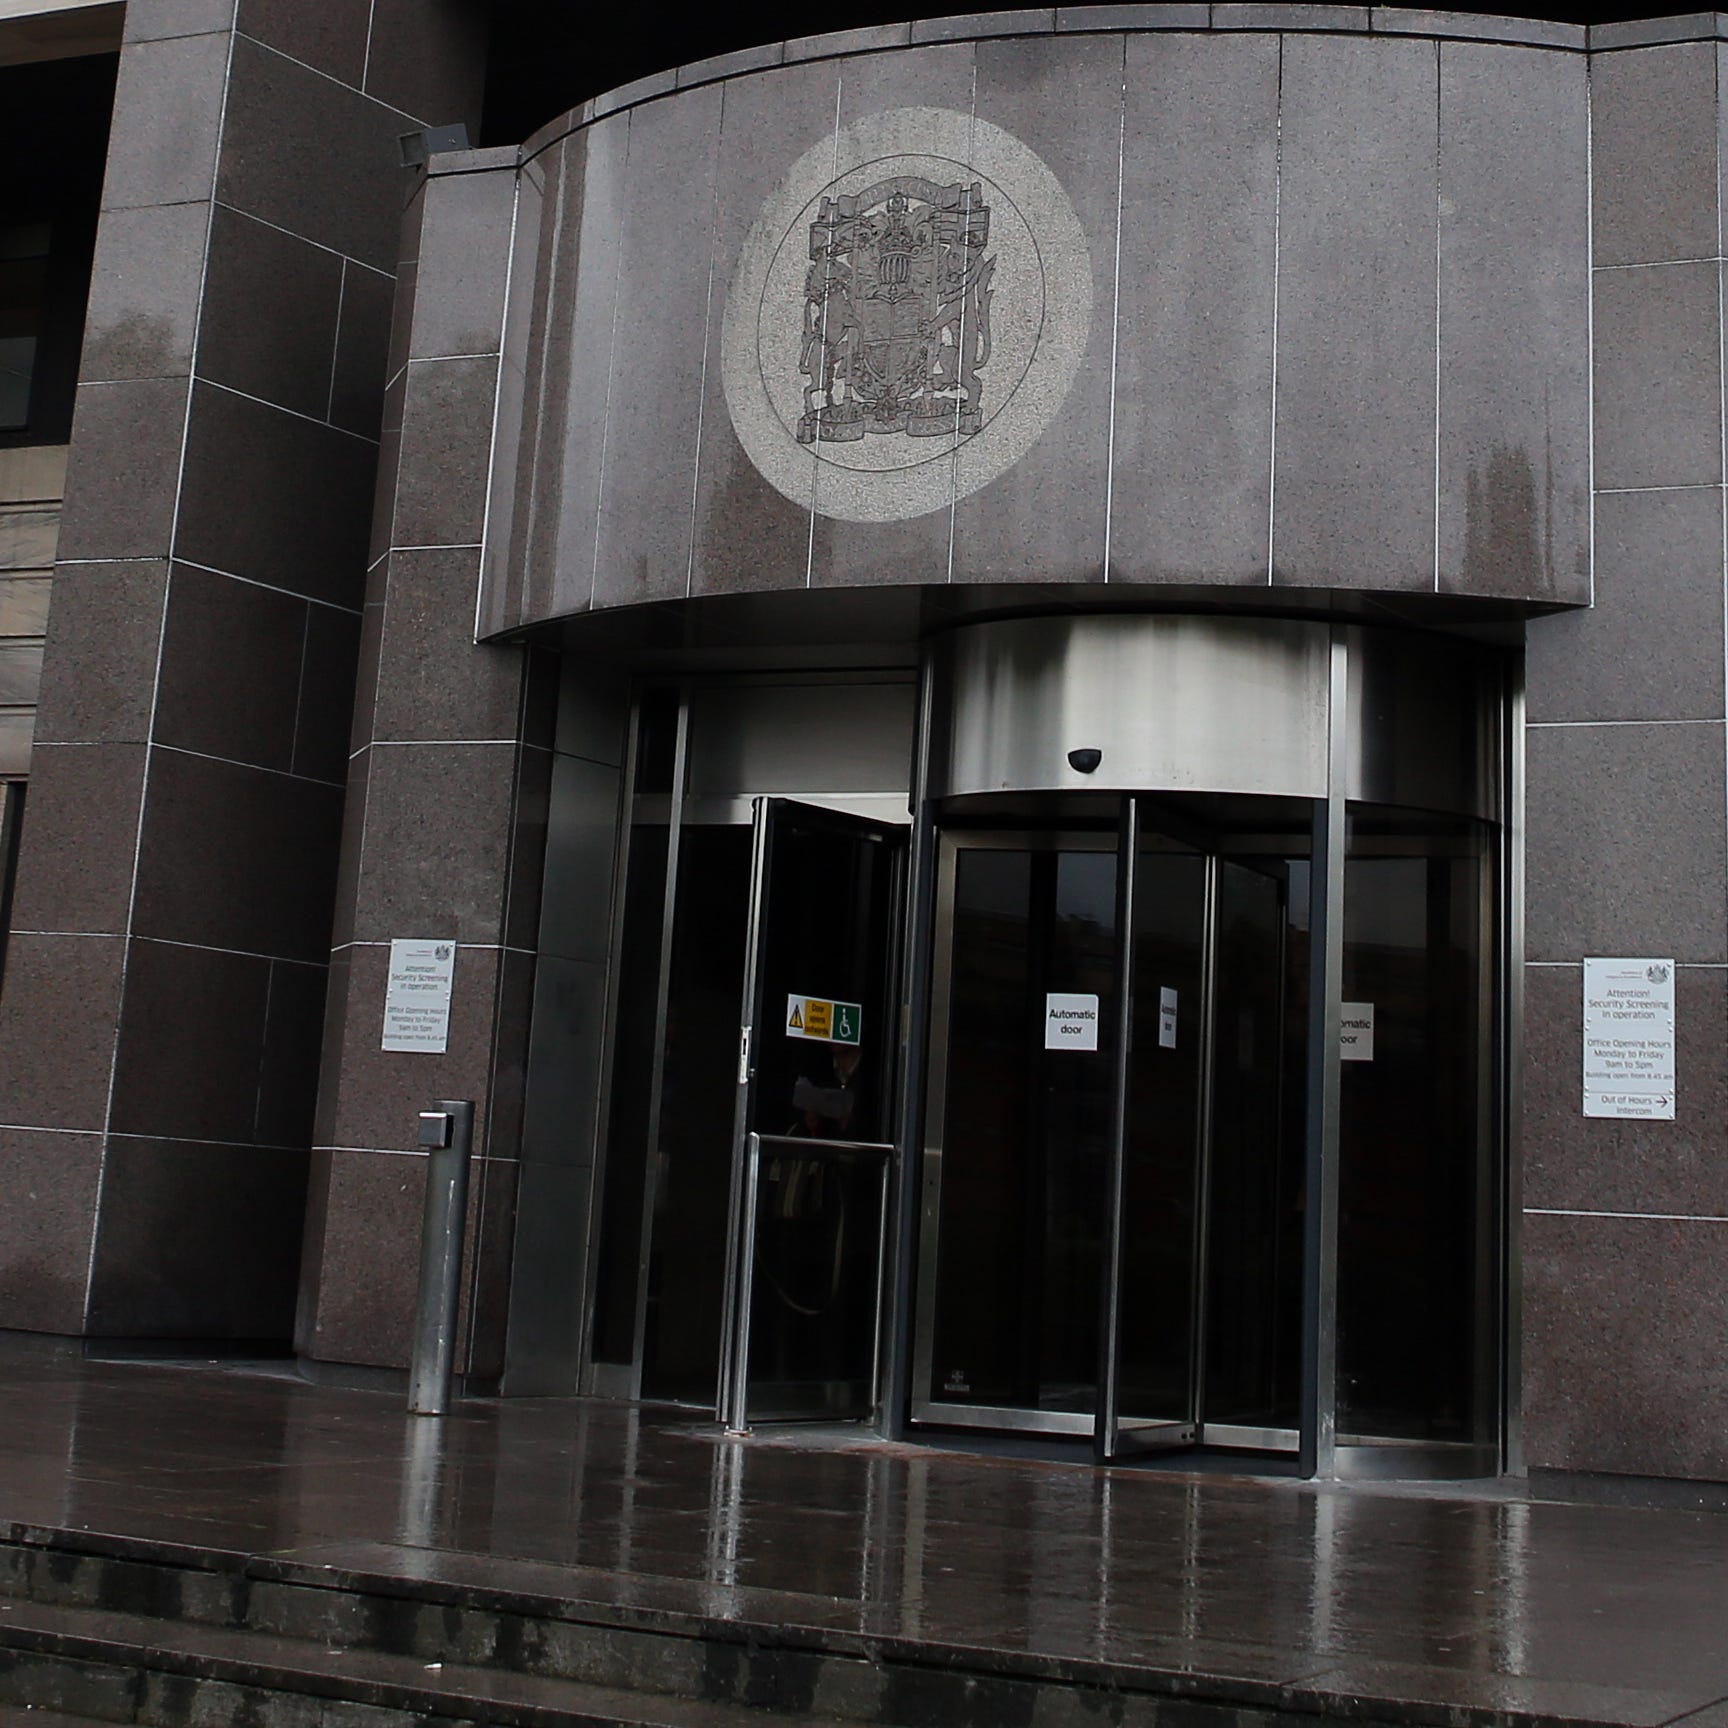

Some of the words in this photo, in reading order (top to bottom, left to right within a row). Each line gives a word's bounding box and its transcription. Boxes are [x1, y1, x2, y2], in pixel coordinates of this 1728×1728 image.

[1588, 999, 1625, 1009] Security
[1626, 999, 1670, 1010] Screening
[1049, 1008, 1096, 1020] Automatic
[1613, 1010, 1656, 1020] operation
[1060, 1024, 1083, 1034] door
[1587, 1039, 1610, 1047] Office
[1613, 1039, 1647, 1049] Opening
[1648, 1040, 1672, 1048] Hours
[1594, 1050, 1625, 1059] Monday
[1628, 1050, 1637, 1058] to
[1639, 1051, 1665, 1060] Friday
[1625, 1060, 1633, 1068] to
[1601, 1095, 1616, 1104] Out
[1617, 1095, 1627, 1104] of
[1628, 1096, 1652, 1105] Hours
